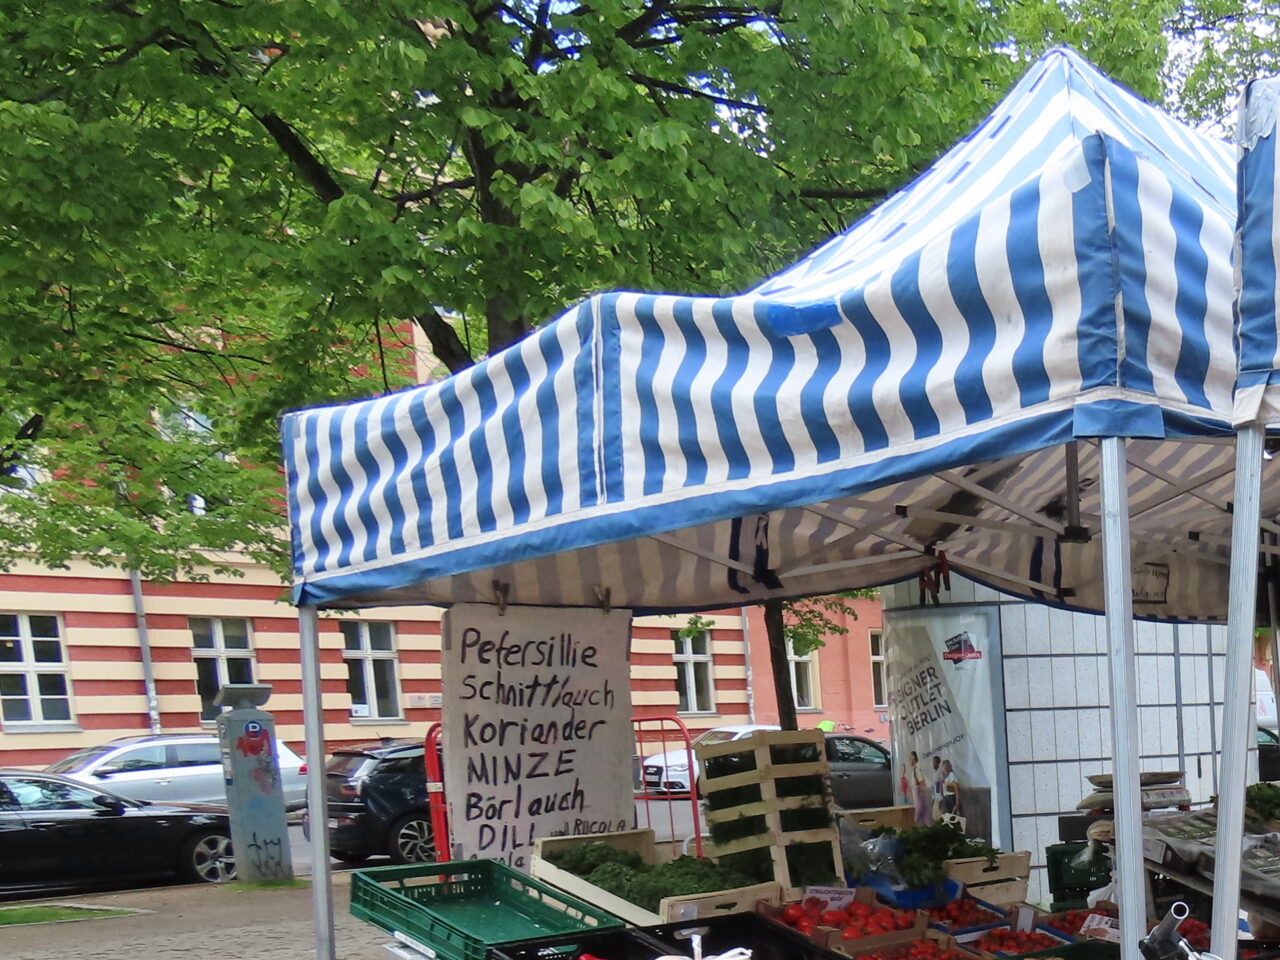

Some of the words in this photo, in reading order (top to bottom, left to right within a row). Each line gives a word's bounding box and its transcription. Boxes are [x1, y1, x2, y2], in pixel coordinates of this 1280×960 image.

[463, 712, 606, 748] Koriander
[467, 749, 576, 786] MINZE
[478, 822, 536, 851] DILL
